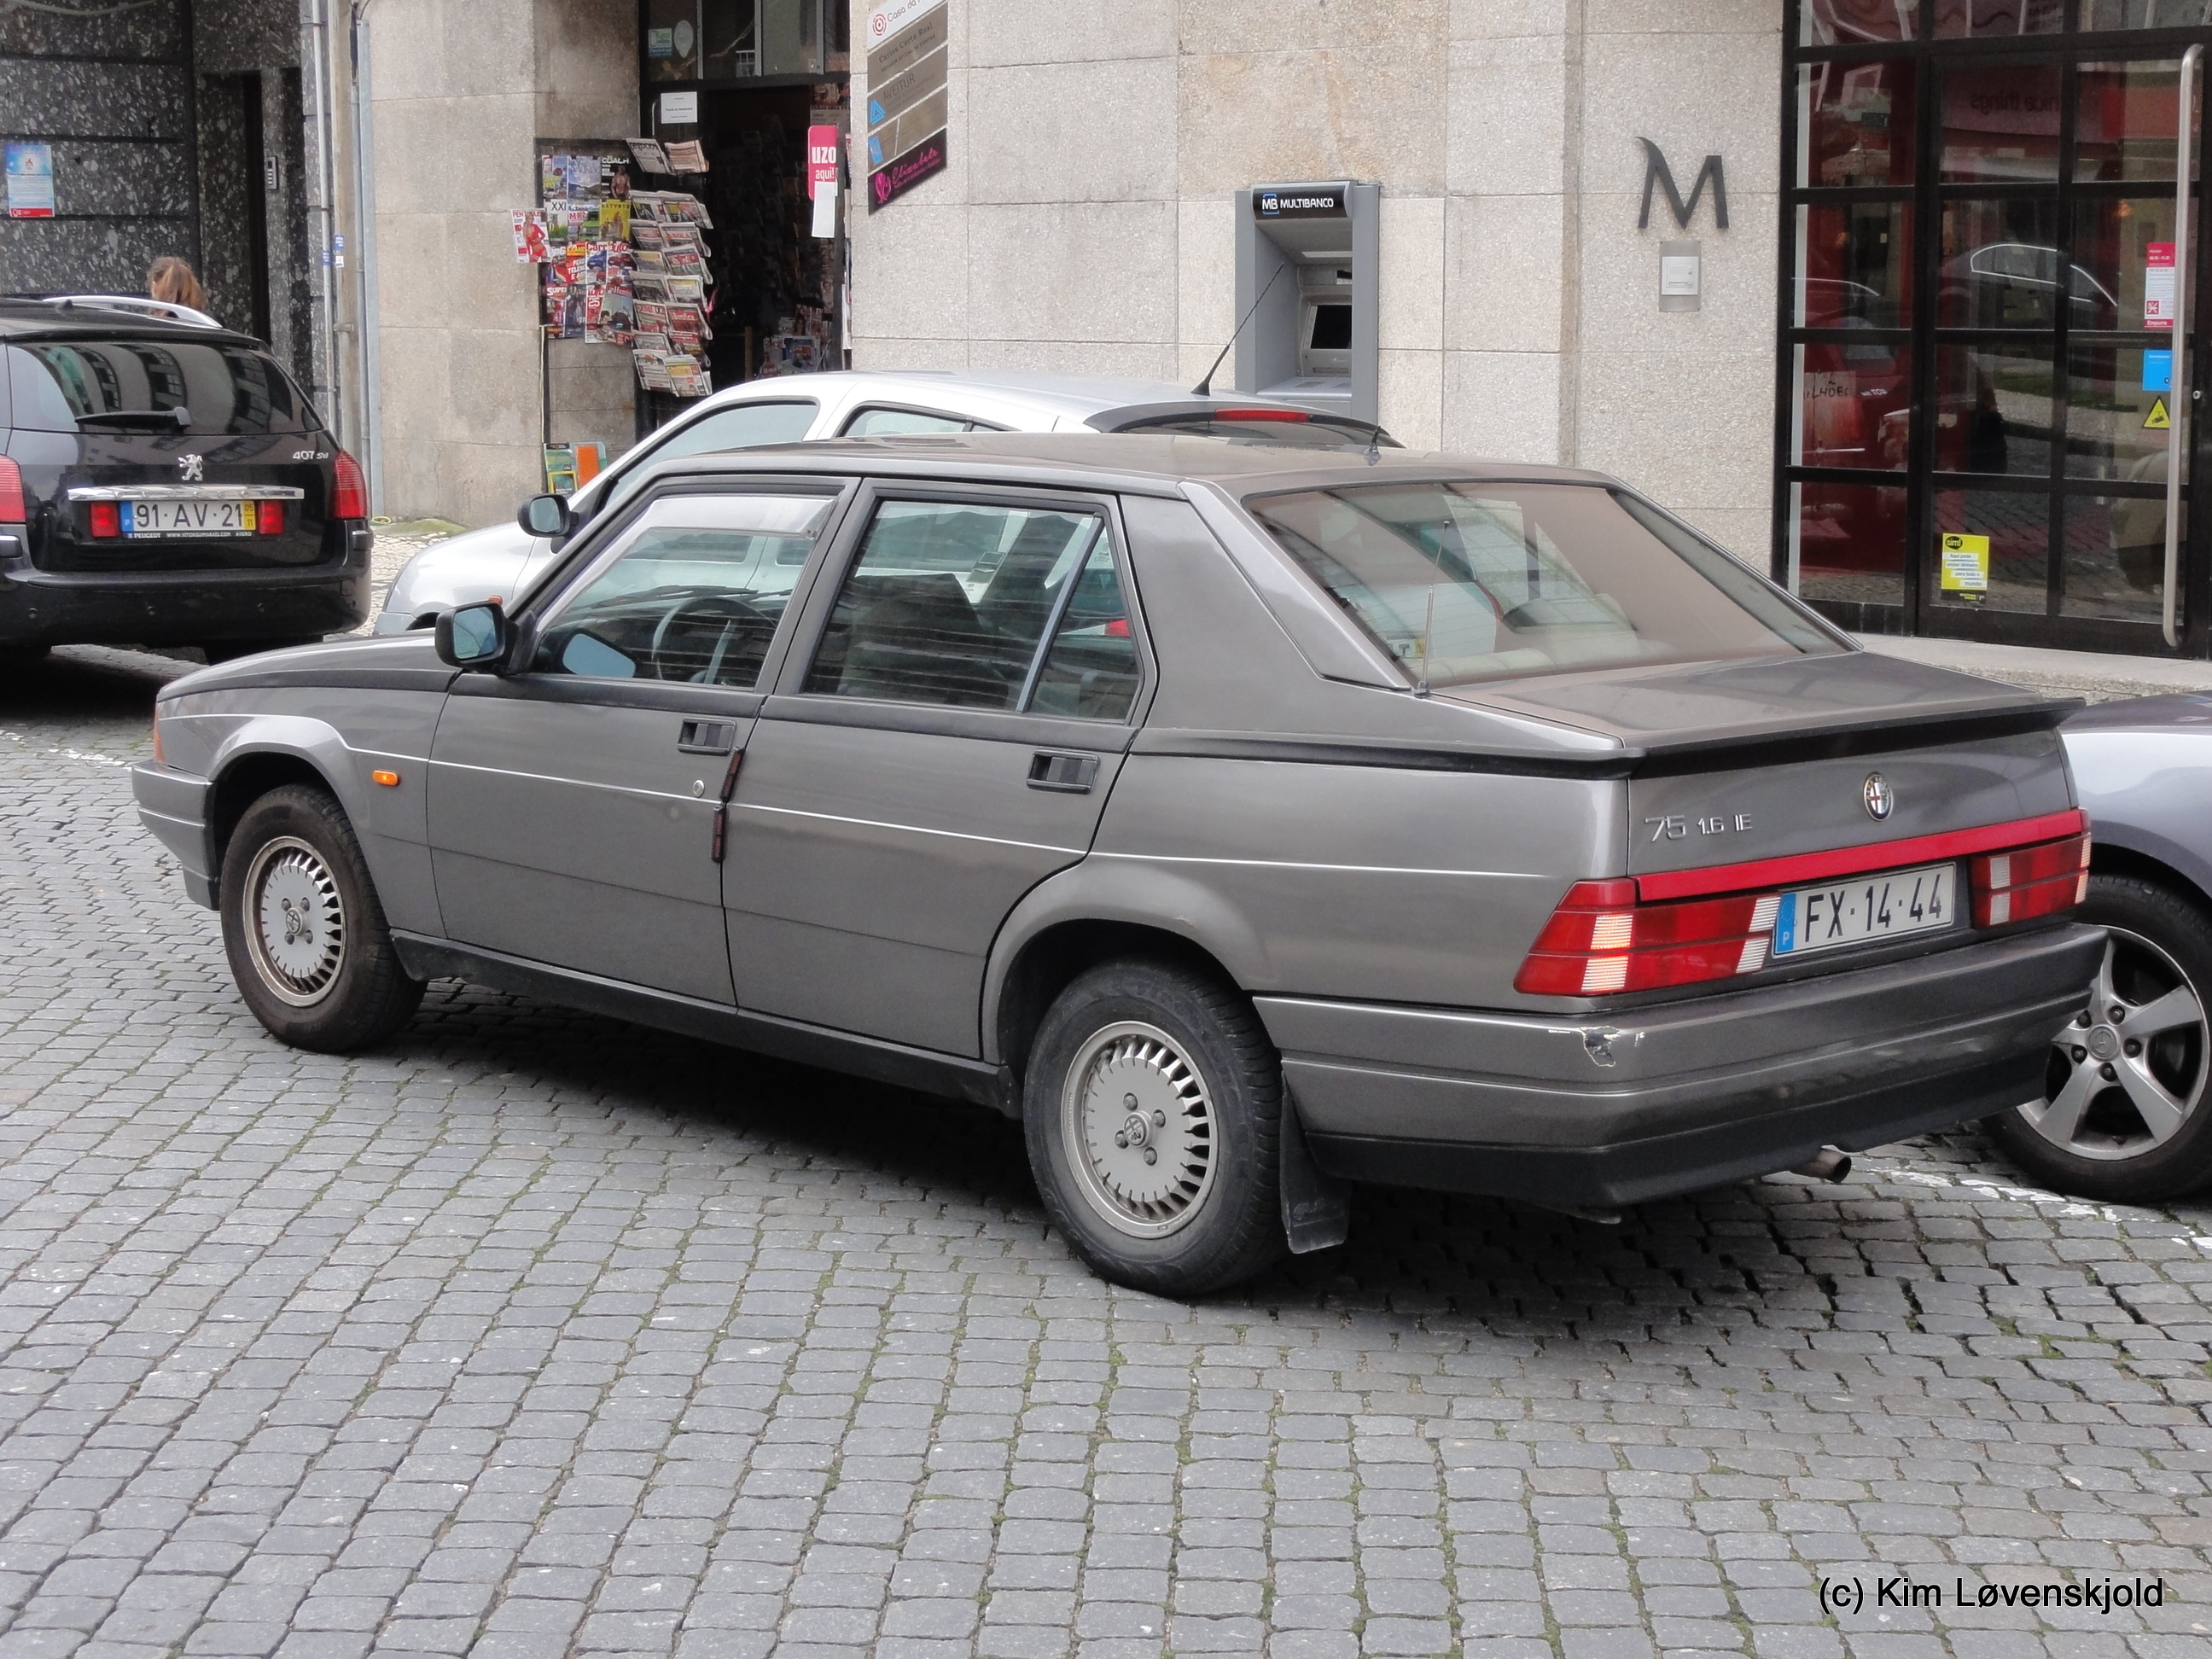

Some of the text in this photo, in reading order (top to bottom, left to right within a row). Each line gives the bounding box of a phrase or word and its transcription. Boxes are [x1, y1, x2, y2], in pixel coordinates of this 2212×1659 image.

[887, 7, 905, 22] Casa
[879, 46, 899, 63] Carlos
[899, 35, 917, 49] Corte
[918, 22, 934, 37] Real
[883, 73, 916, 101] AVEITUR
[812, 146, 836, 165] uzo
[815, 166, 835, 182] aqui!
[551, 201, 567, 212] XXI
[1261, 197, 1334, 210] MB MULTIBANCO
[293, 451, 315, 460] 407
[245, 504, 253, 512] 05
[1644, 814, 1686, 841] 75
[1697, 817, 1724, 835] 1.6
[1783, 931, 1790, 946] P
